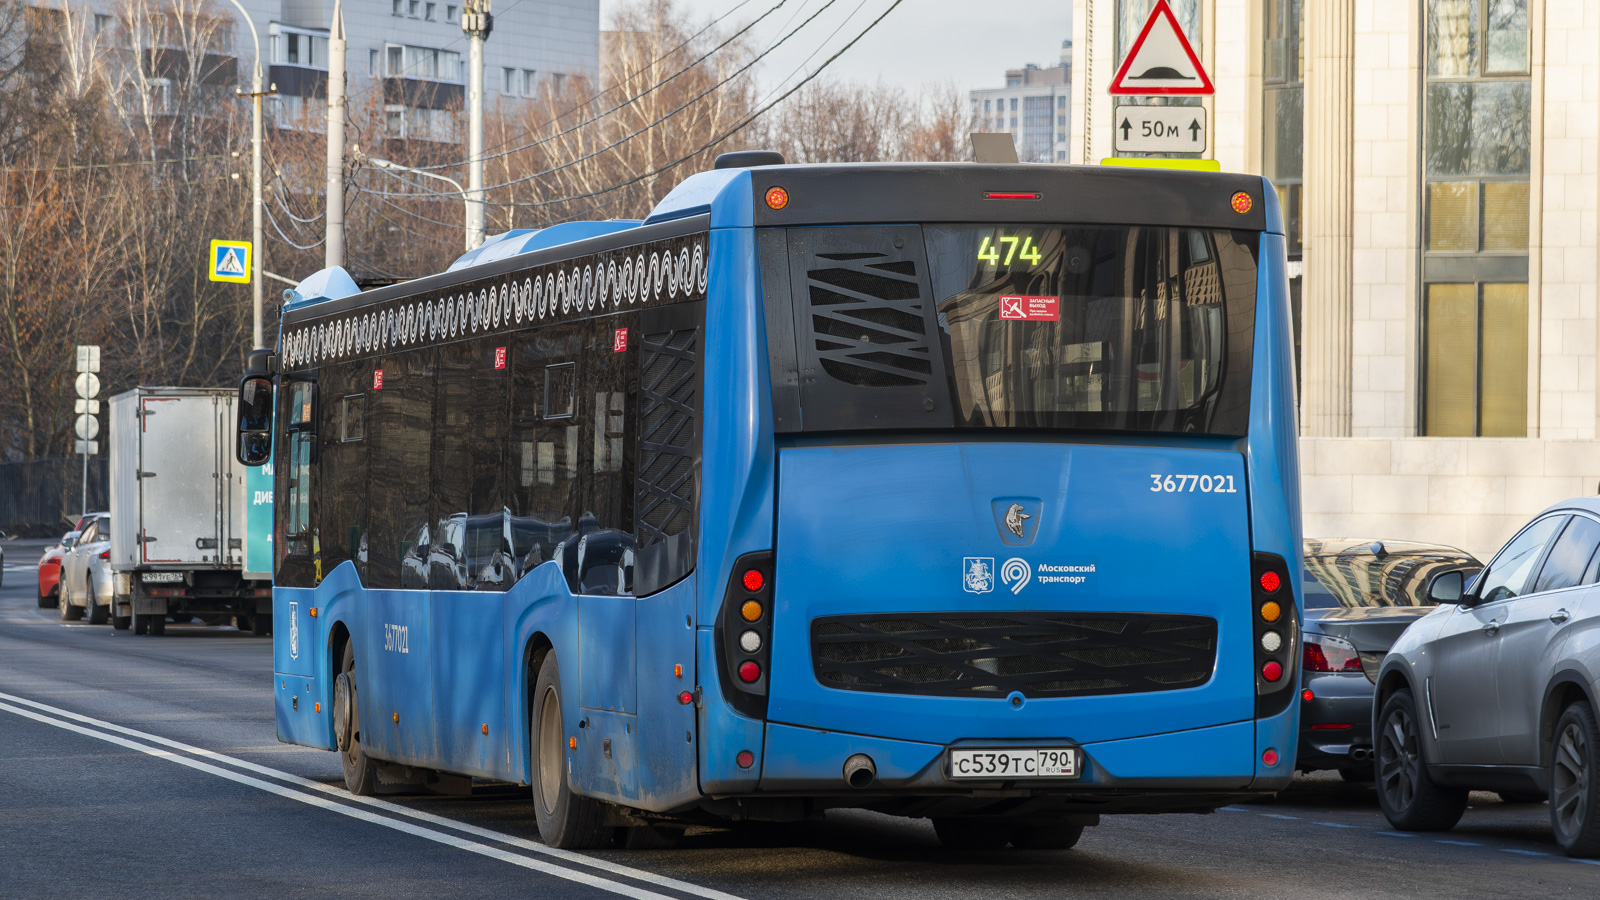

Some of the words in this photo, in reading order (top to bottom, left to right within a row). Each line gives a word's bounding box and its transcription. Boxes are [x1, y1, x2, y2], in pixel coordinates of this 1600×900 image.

[977, 236, 1042, 266] 474
[1149, 474, 1238, 493] 3677021
[1038, 563, 1096, 573] Московский
[1038, 576, 1086, 584] транспорт
[384, 623, 409, 654] 3677021
[958, 753, 1036, 774] С539ТС
[1039, 751, 1069, 767] 790
